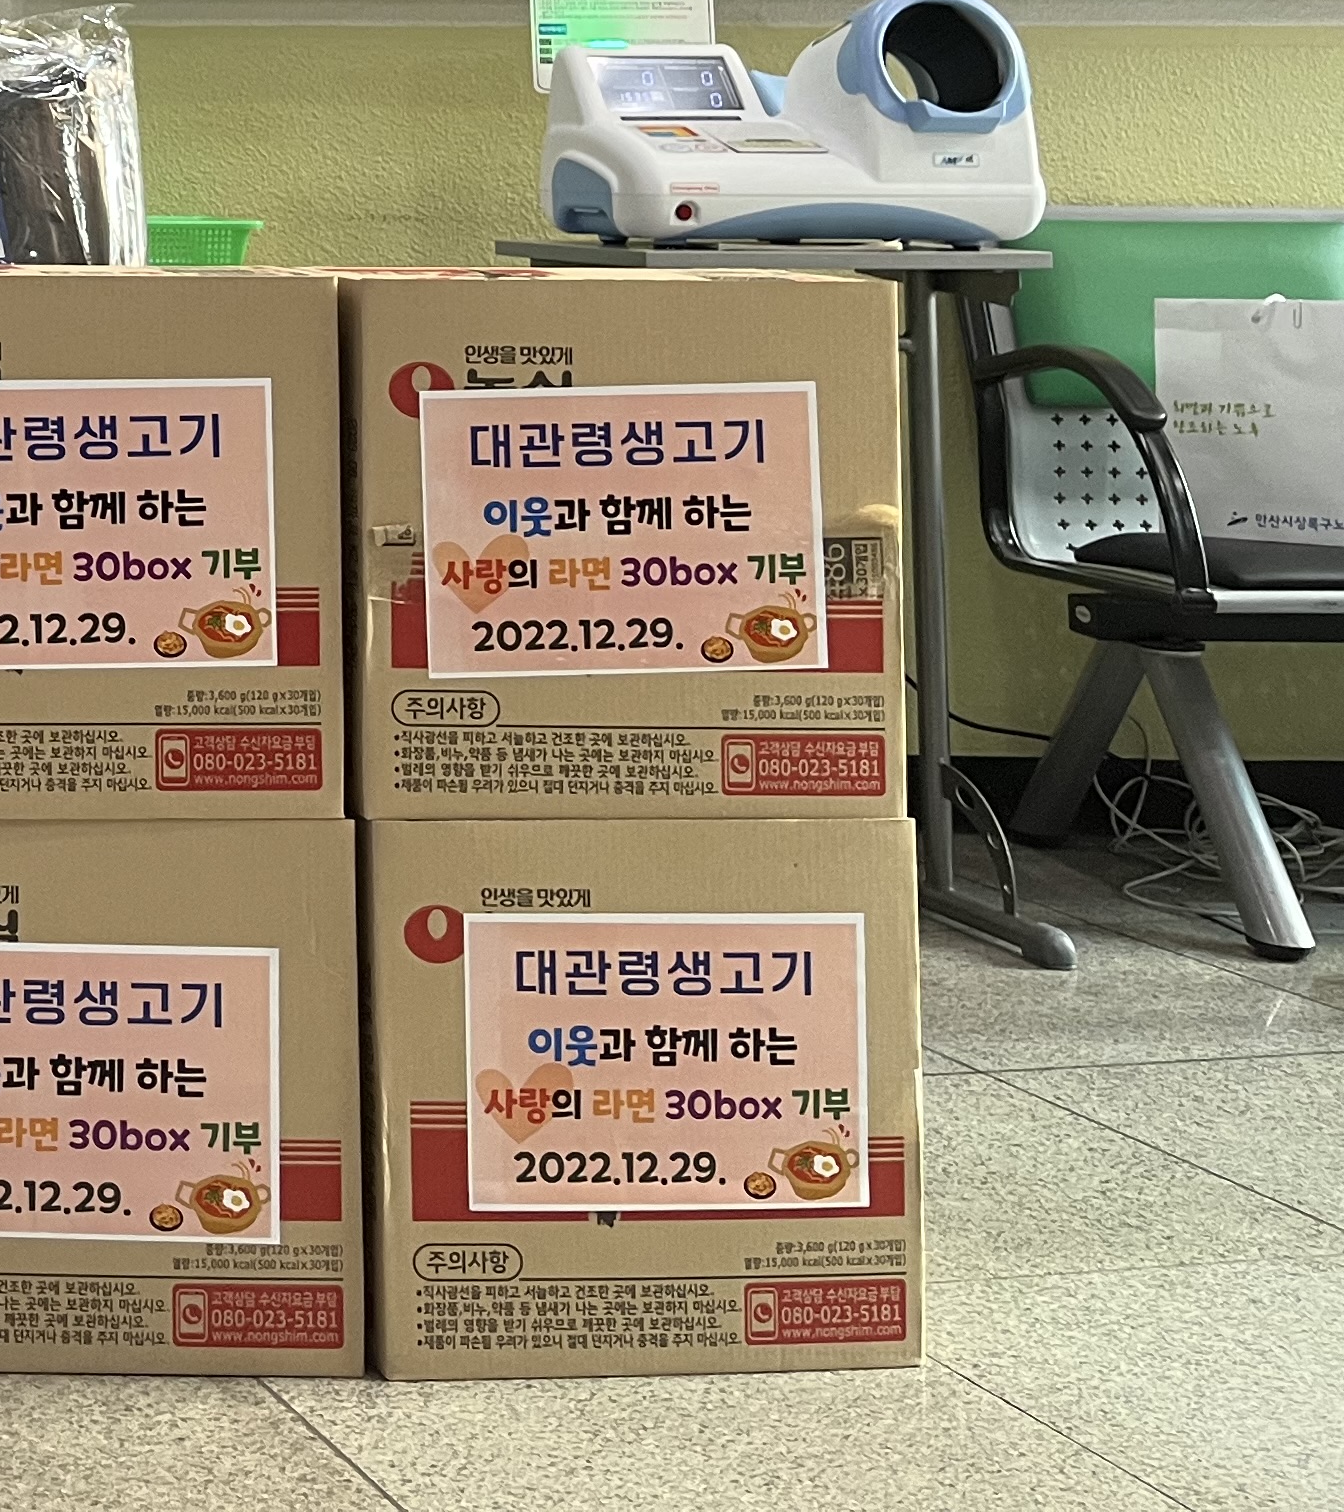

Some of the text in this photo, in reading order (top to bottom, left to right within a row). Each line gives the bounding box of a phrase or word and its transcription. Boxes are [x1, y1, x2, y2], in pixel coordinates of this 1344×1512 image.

[470, 419, 765, 468] 대관령생고기
[51, 488, 126, 530] 함께
[137, 489, 207, 527] 하는
[484, 494, 752, 537] 이웃과 함께 하는
[0, 551, 62, 586] 라면
[73, 550, 192, 582] 30box
[201, 548, 262, 579] 기부
[442, 552, 807, 594] 사랑의 라면 30box 기부
[472, 618, 684, 653] 2022.12.29.
[193, 753, 318, 771] 080-023-5181
[194, 773, 317, 789] www.nongshim.com
[516, 950, 811, 997] 대관령생고기
[528, 1024, 798, 1067] 이웃과 함께 하는
[484, 1088, 850, 1124] 사랑의 라면 30box 기부
[514, 1151, 727, 1186] 2022.12.29.
